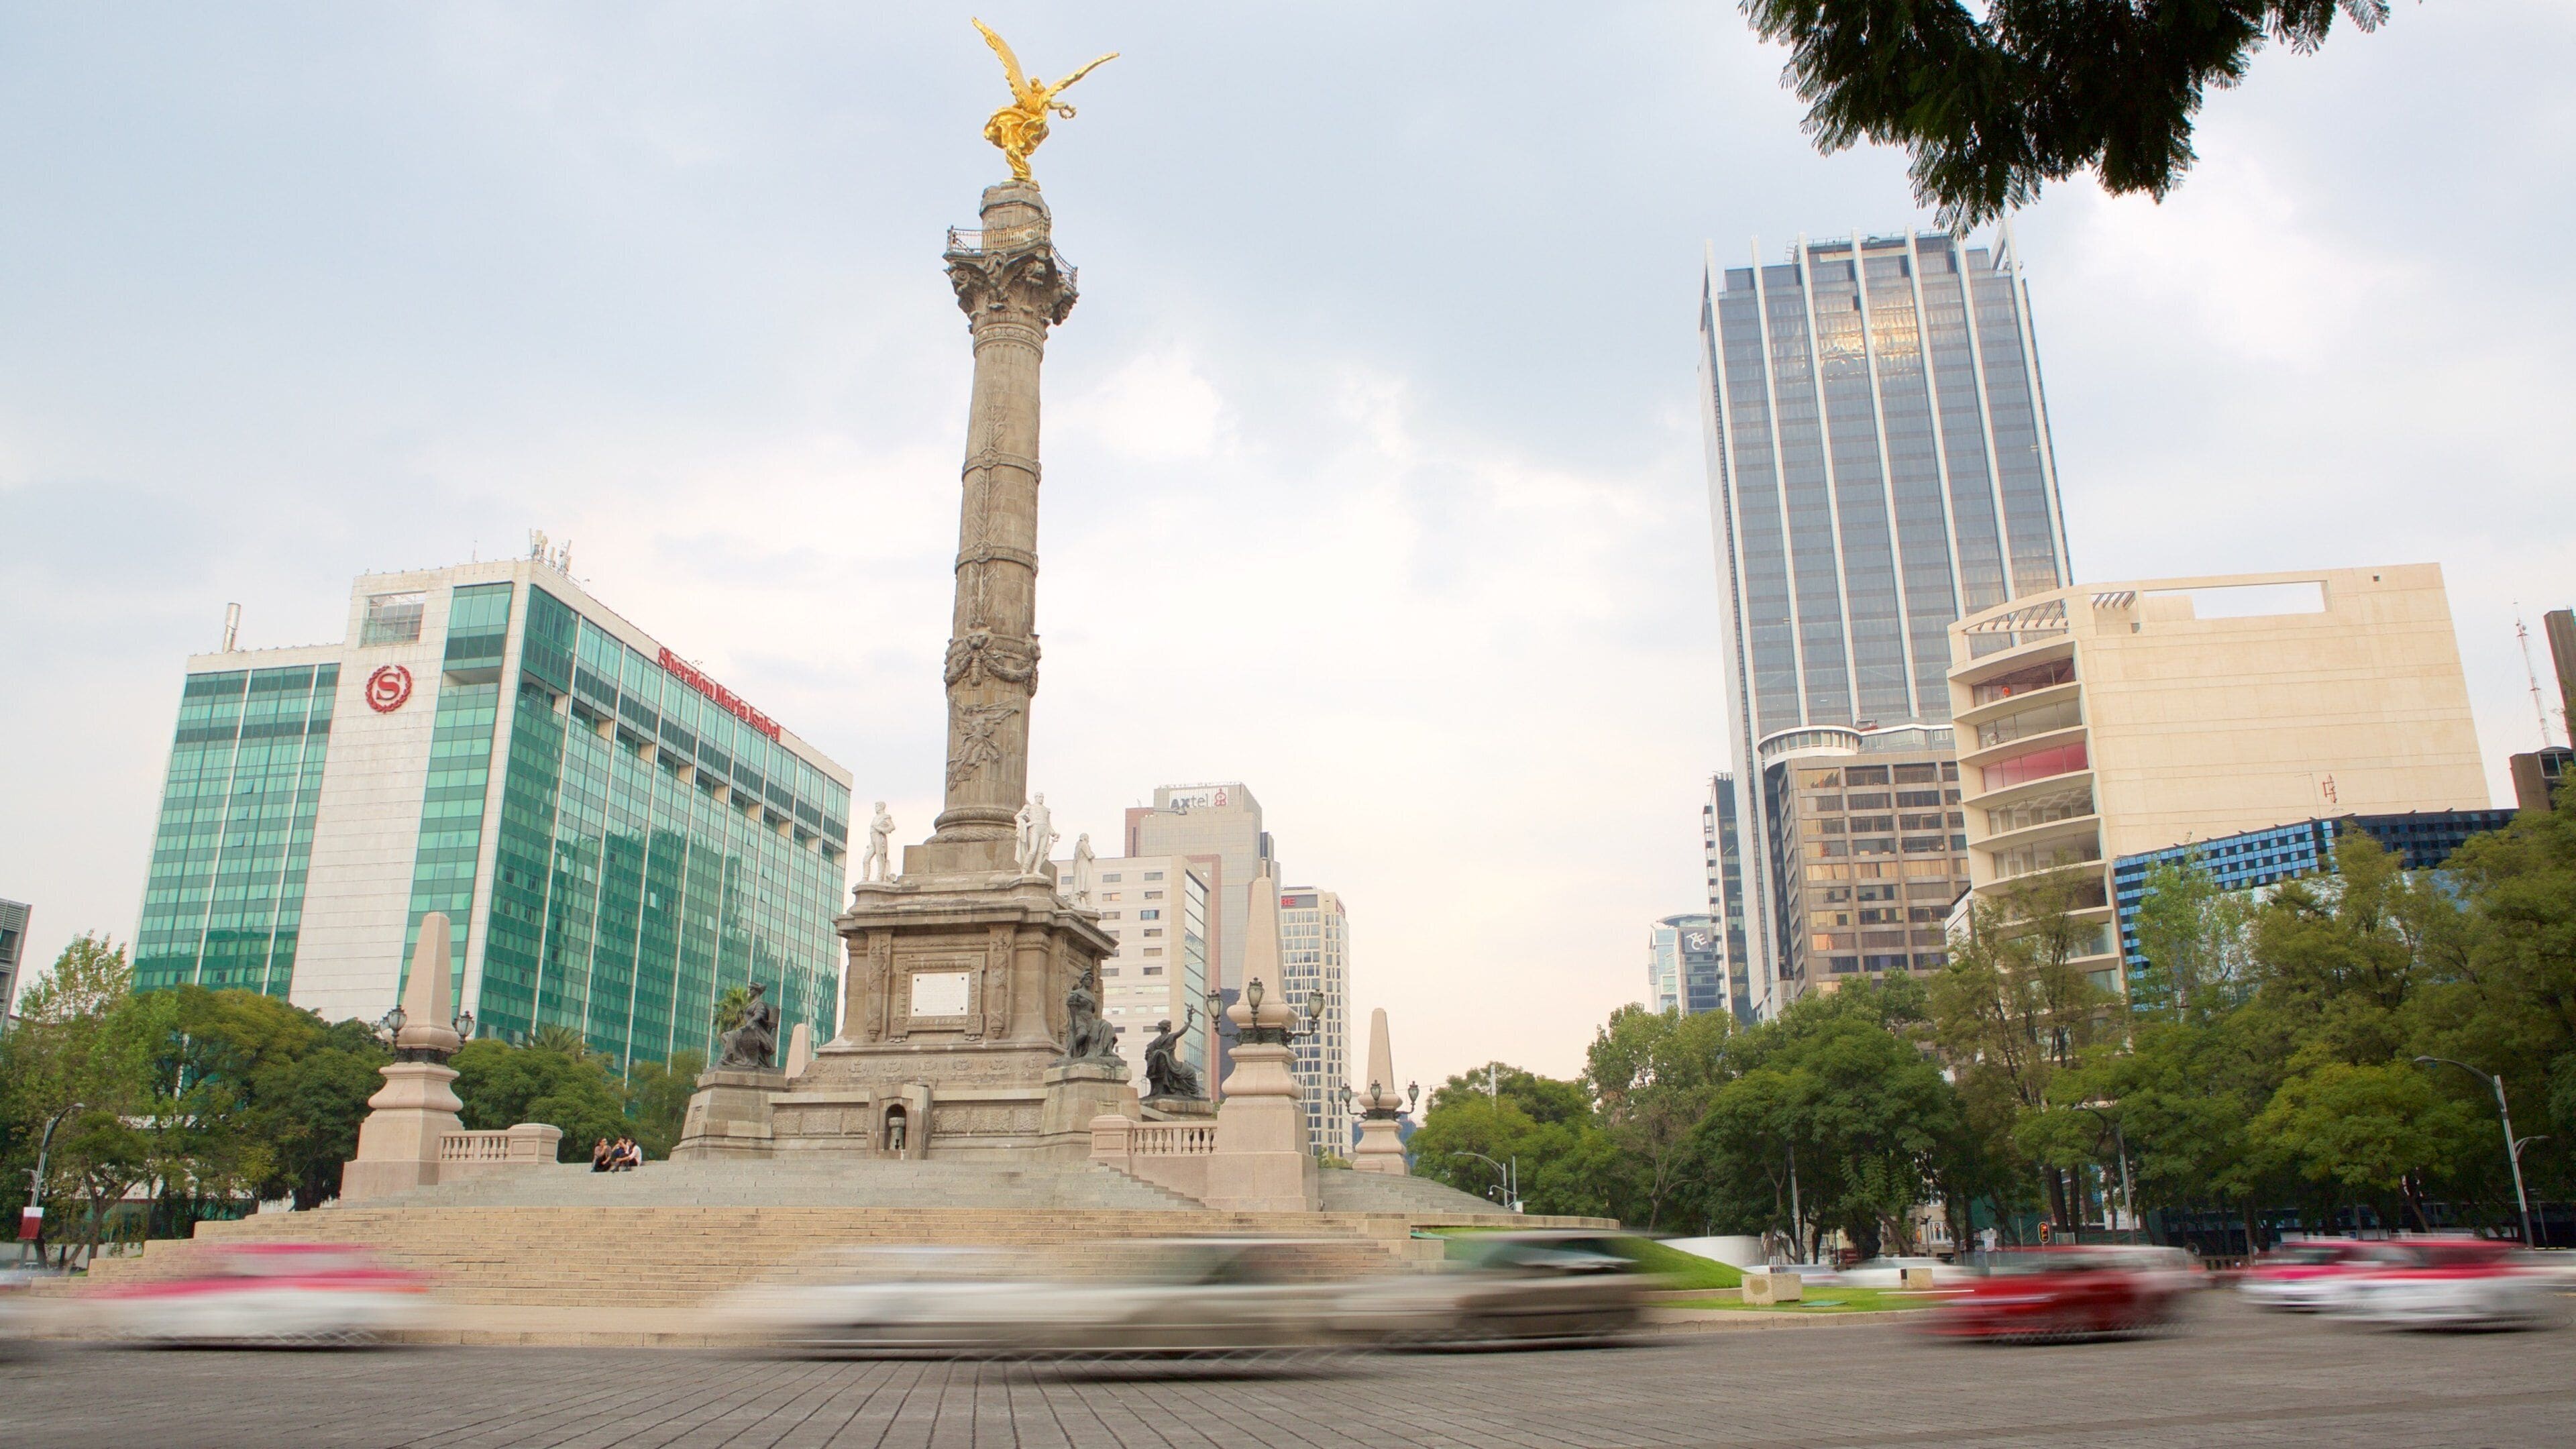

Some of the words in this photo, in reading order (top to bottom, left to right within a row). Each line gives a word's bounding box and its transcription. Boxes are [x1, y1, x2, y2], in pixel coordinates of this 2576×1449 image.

[376, 672, 400, 700] S
[658, 647, 714, 699] Sheraton
[749, 706, 781, 742] Isabel
